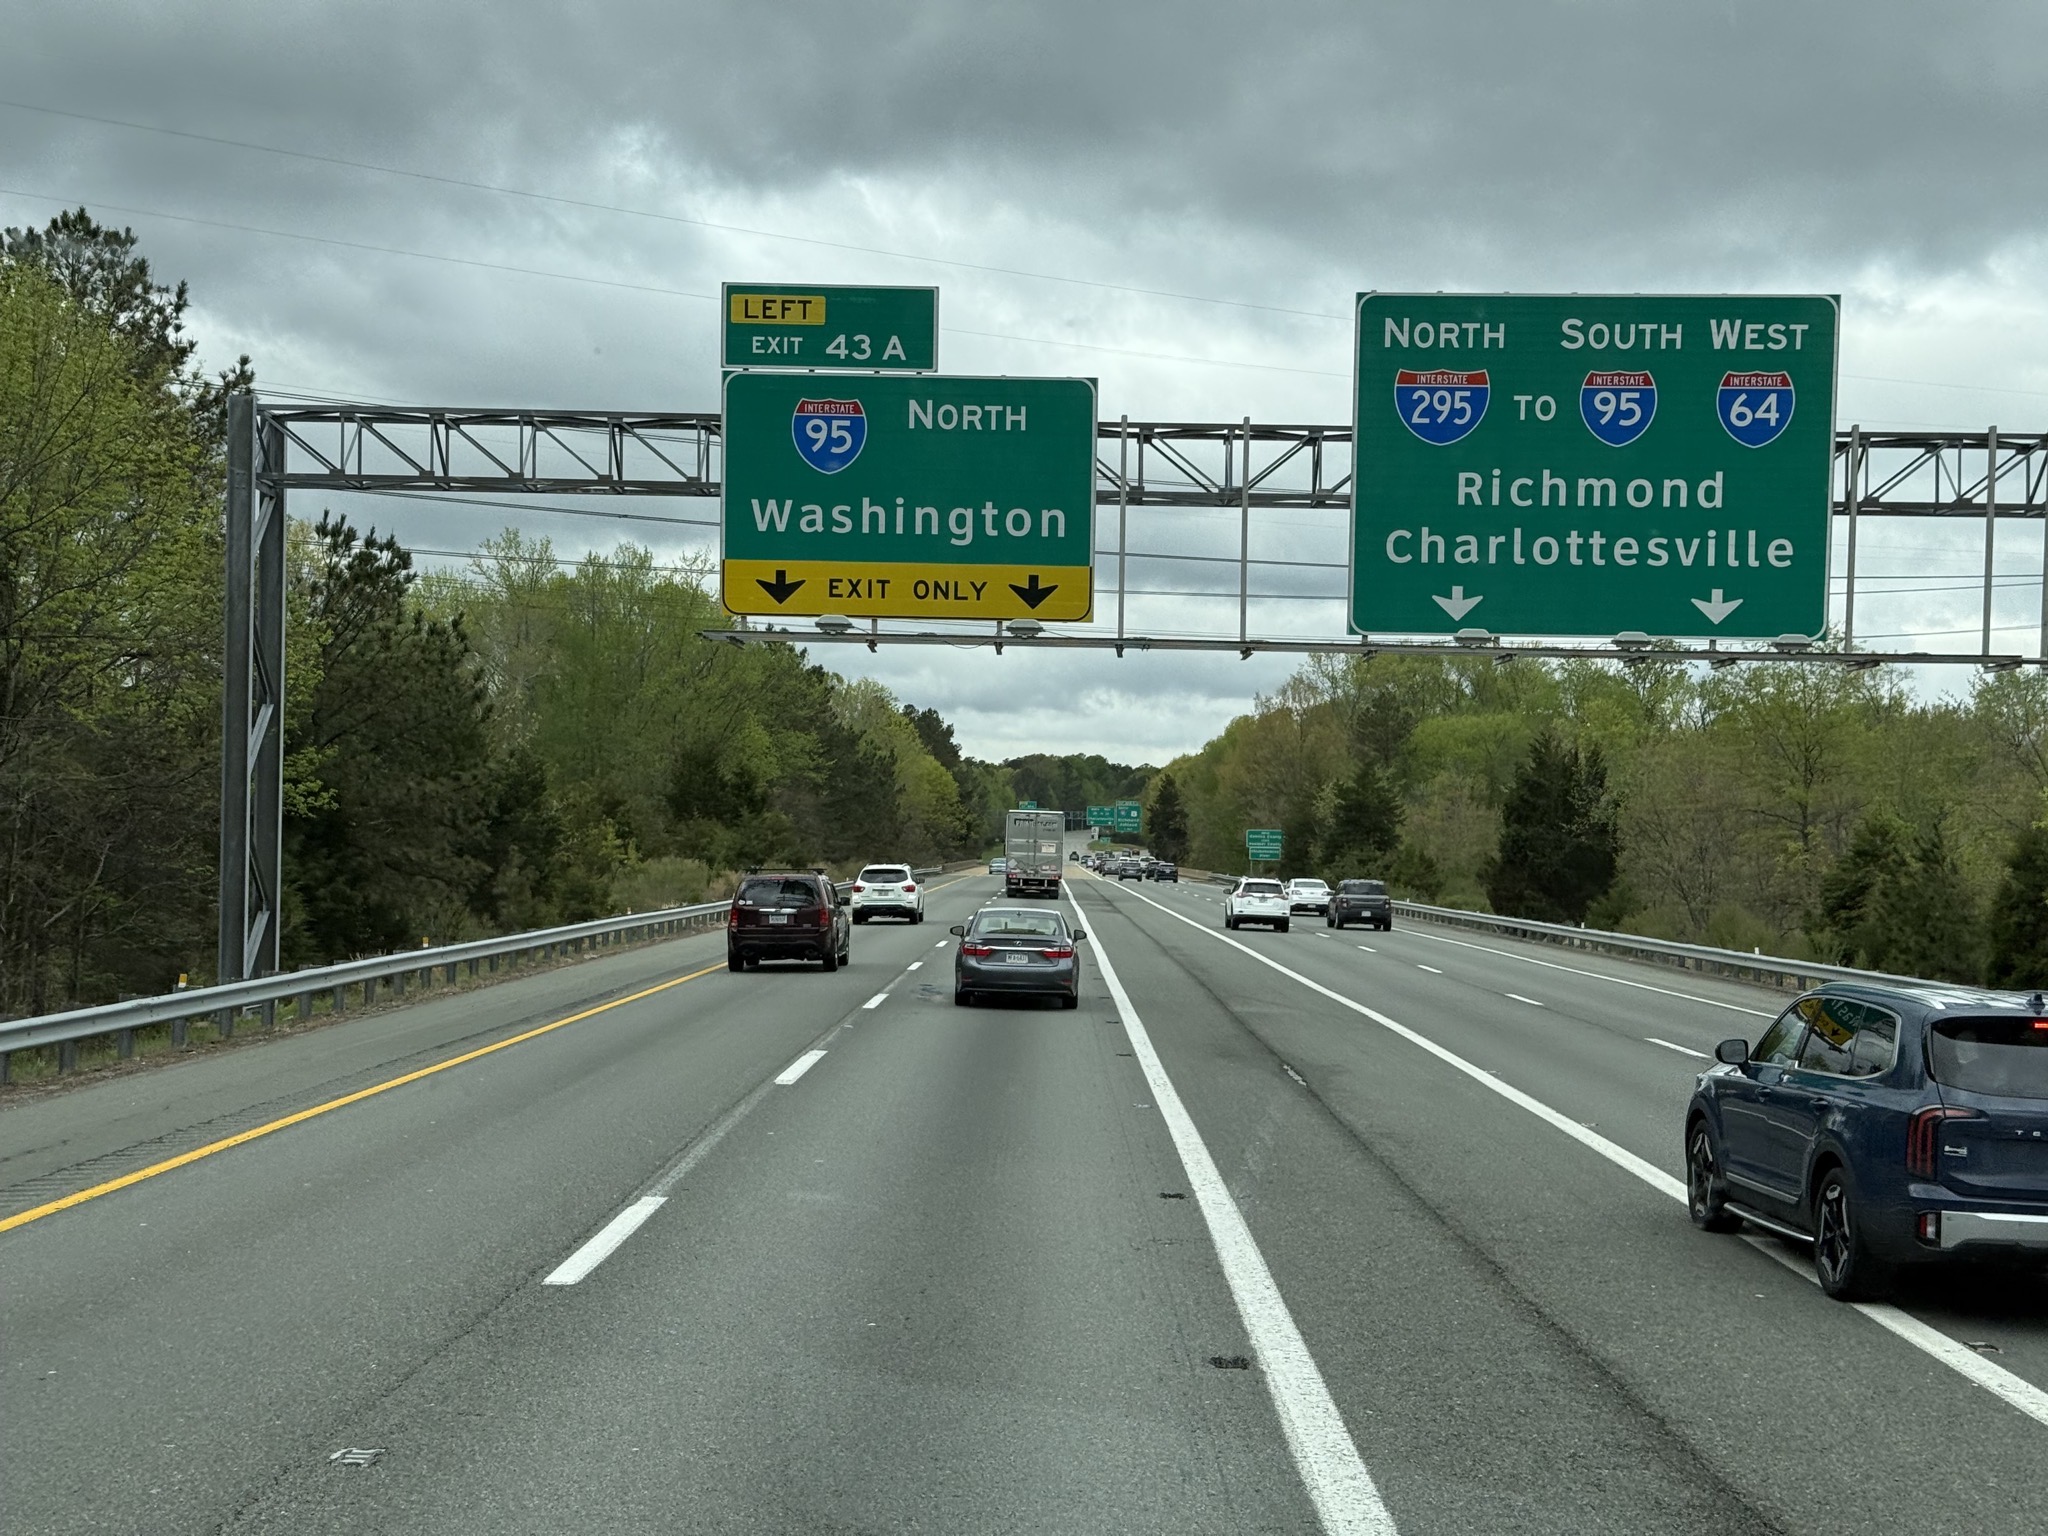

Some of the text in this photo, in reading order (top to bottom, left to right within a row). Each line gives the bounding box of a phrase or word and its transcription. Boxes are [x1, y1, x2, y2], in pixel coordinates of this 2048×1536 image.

[744, 299, 813, 320] LEFT
[751, 334, 907, 361] EXIT 43 A
[1384, 317, 1809, 351] NORTH SOUTH WEST
[1416, 373, 1469, 385] INTERSTATE
[1592, 374, 1645, 387] INTERSTATE
[1729, 375, 1783, 387] INTERSTATE
[804, 402, 856, 415] INTERSTATE
[908, 399, 1027, 432] NORTH
[1410, 389, 1472, 425] 295
[1513, 394, 1557, 421] TO
[1592, 391, 1642, 427] 95
[1728, 392, 1780, 428] 64
[805, 418, 853, 454] 95
[1456, 468, 1724, 509] Richmond
[751, 497, 1066, 546] Washington
[1386, 526, 1795, 568] Charlottesville
[828, 578, 988, 601] EXIT ONLY
